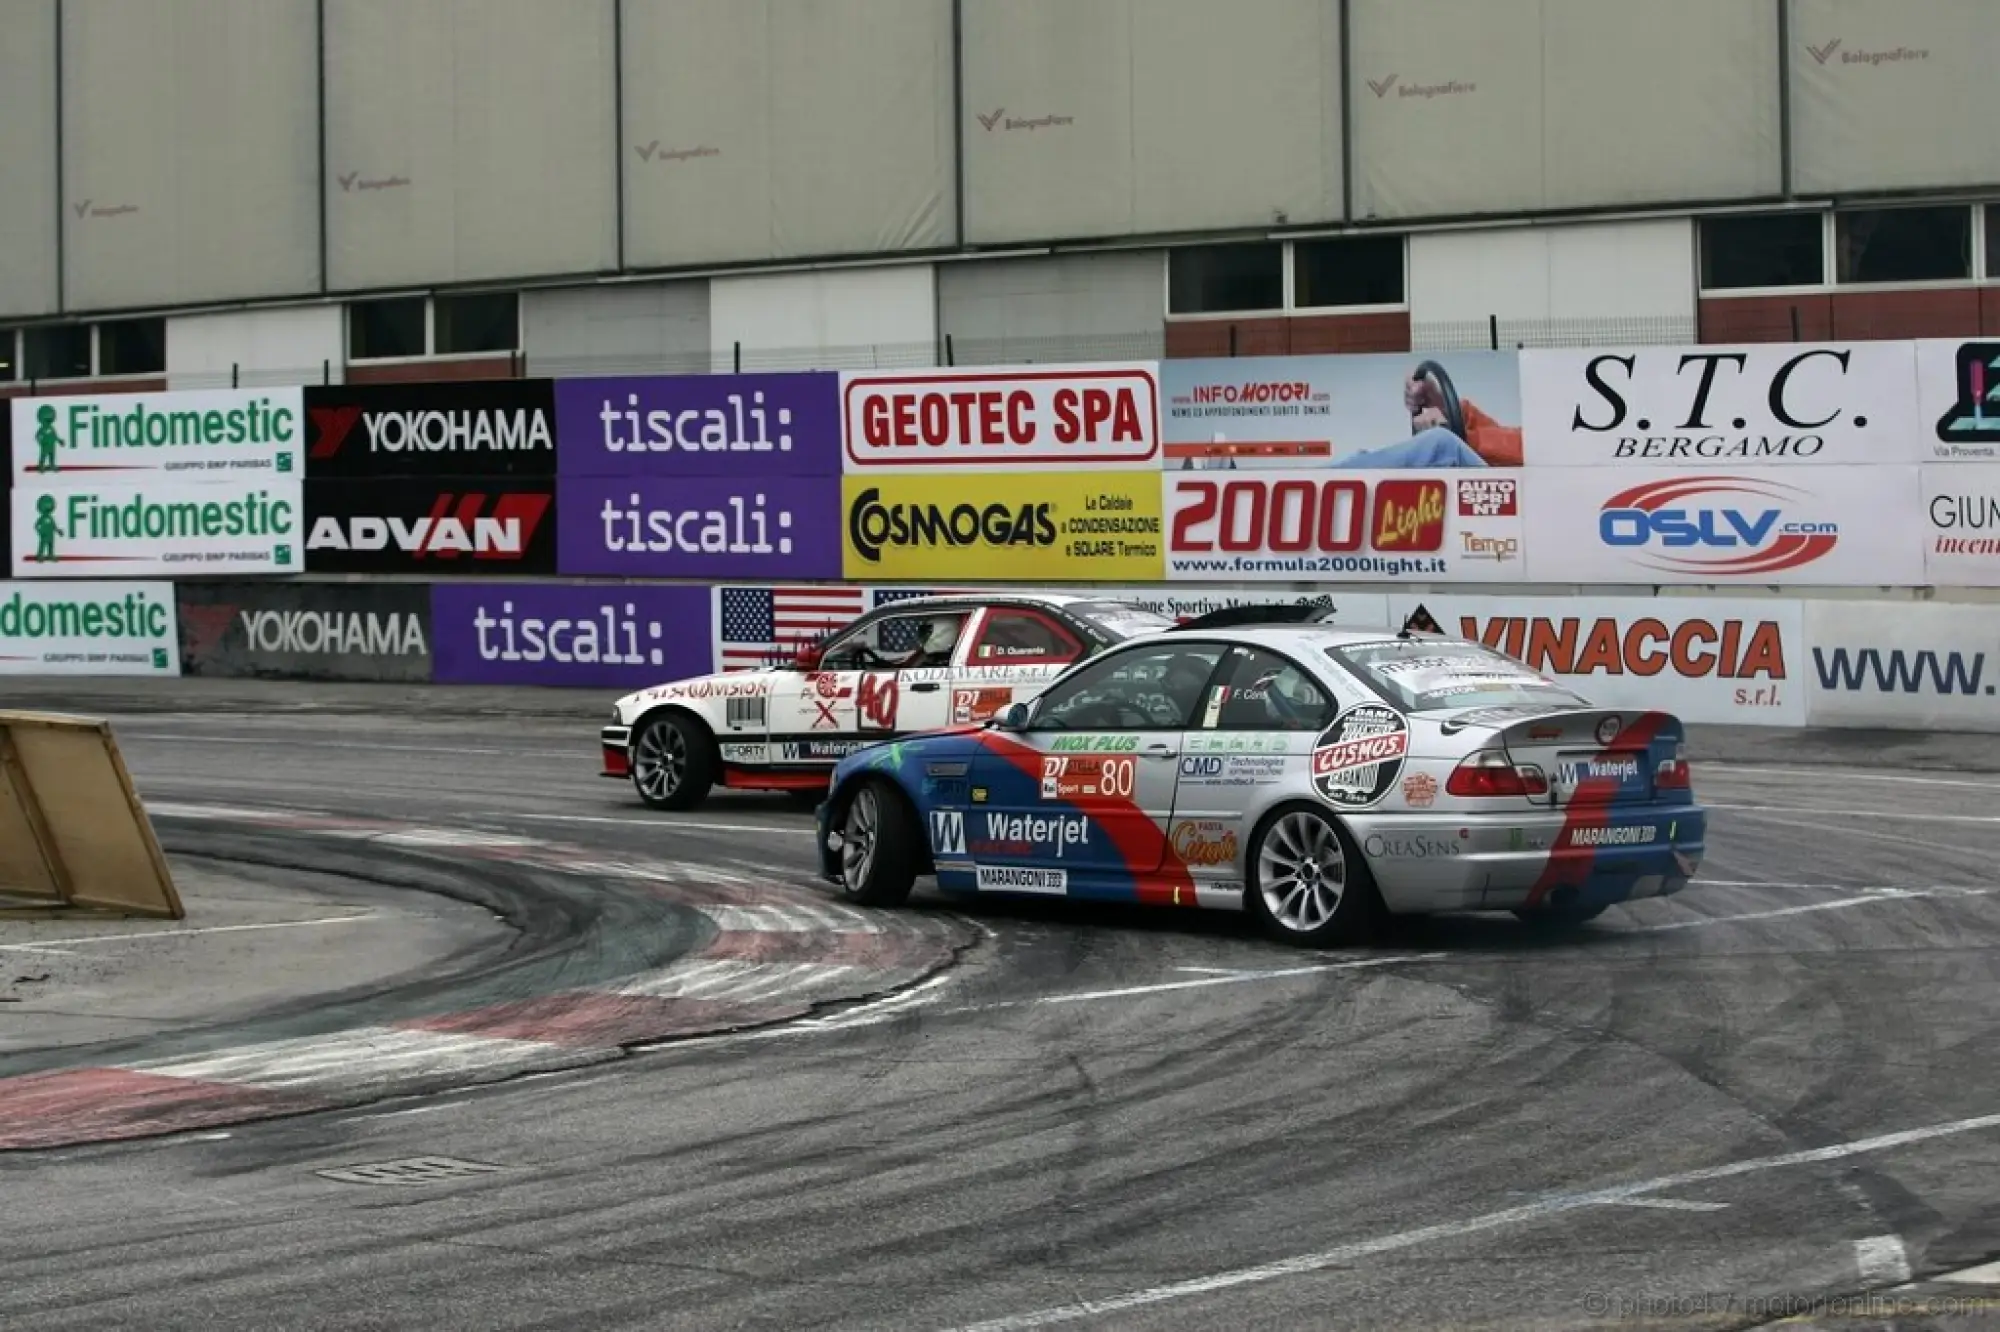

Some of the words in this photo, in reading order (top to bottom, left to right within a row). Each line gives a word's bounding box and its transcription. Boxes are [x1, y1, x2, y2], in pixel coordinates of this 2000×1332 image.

[1571, 350, 1868, 432] S.T.C.
[68, 398, 293, 448] Findomestic
[362, 408, 553, 451] YOKOHAMA
[600, 392, 792, 453] tiscali:
[863, 390, 1035, 448] GEOTEC
[1054, 387, 1143, 444] SPA
[1613, 435, 1825, 458] BERGAMO
[1460, 481, 1515, 491] AUTO
[67, 490, 292, 539] Findomestic
[305, 516, 522, 552] ADVAN
[600, 493, 792, 553] tiscali:
[850, 488, 1057, 562] COSMOGAS
[1069, 518, 1159, 533] CONDENSAZIONE
[1172, 480, 1366, 551] 2000
[1377, 485, 1444, 546] Light
[1074, 541, 1115, 556] SOLARE
[1117, 541, 1156, 556] Termico
[1173, 557, 1447, 575] www.formula2000light.it
[241, 610, 428, 655] YOKOHAMA
[473, 601, 664, 666] tiscali:
[1460, 616, 1785, 679] VINACCIA
[856, 673, 899, 726] 40
[1734, 685, 1781, 707] s.r.l.
[1093, 735, 1140, 750] PLUS
[1101, 759, 1133, 796] 80
[1181, 757, 1222, 775] CMD
[1229, 757, 1284, 769] Technologies
[1587, 760, 1639, 782] Waterjet
[987, 811, 1089, 858] Waterjet
[1570, 827, 1641, 845] MARANGONI
[979, 869, 1046, 888] MARANGONI
